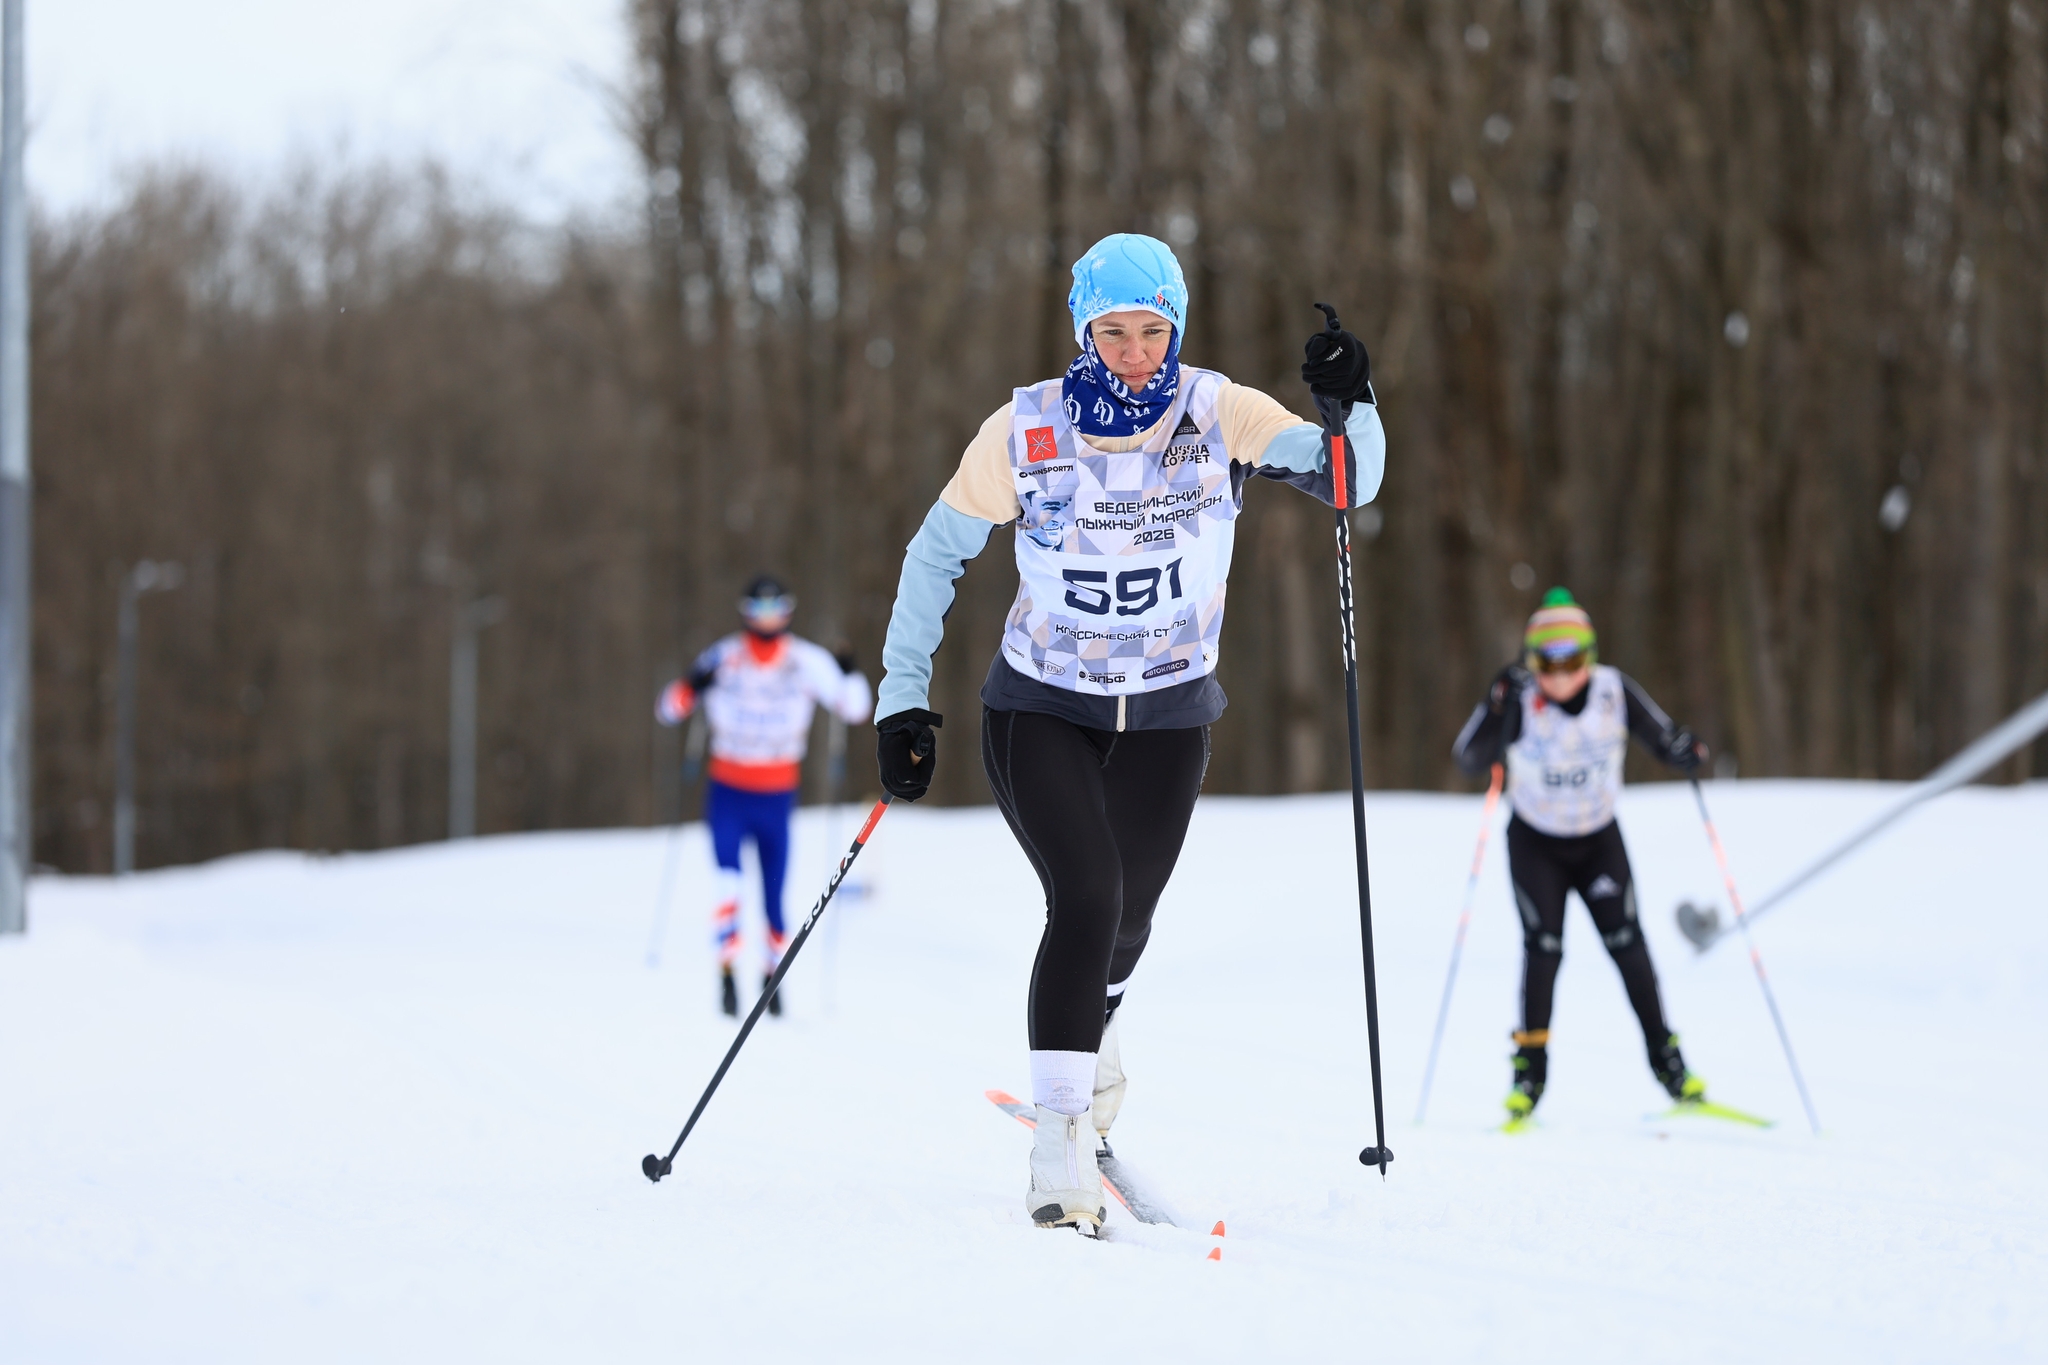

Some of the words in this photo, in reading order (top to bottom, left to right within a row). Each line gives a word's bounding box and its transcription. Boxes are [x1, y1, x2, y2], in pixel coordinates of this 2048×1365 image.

[1163, 443, 1210, 458] RUSSIA
[1162, 454, 1210, 468] LOPPET
[1094, 482, 1205, 515] ВЕДЕНИНСКИЙ
[1075, 512, 1147, 531] ЛЫЖНЫЙ
[1151, 494, 1223, 525] МАРАФОН
[1133, 528, 1175, 546] 2026
[1062, 556, 1183, 616] 591
[1055, 623, 1150, 641] КЛАССИЧЕСКИЙ
[1153, 619, 1187, 638] СТЛЬ
[1145, 661, 1186, 678] АВТОКЛАСС
[1088, 675, 1126, 684] ЭЛЬФ
